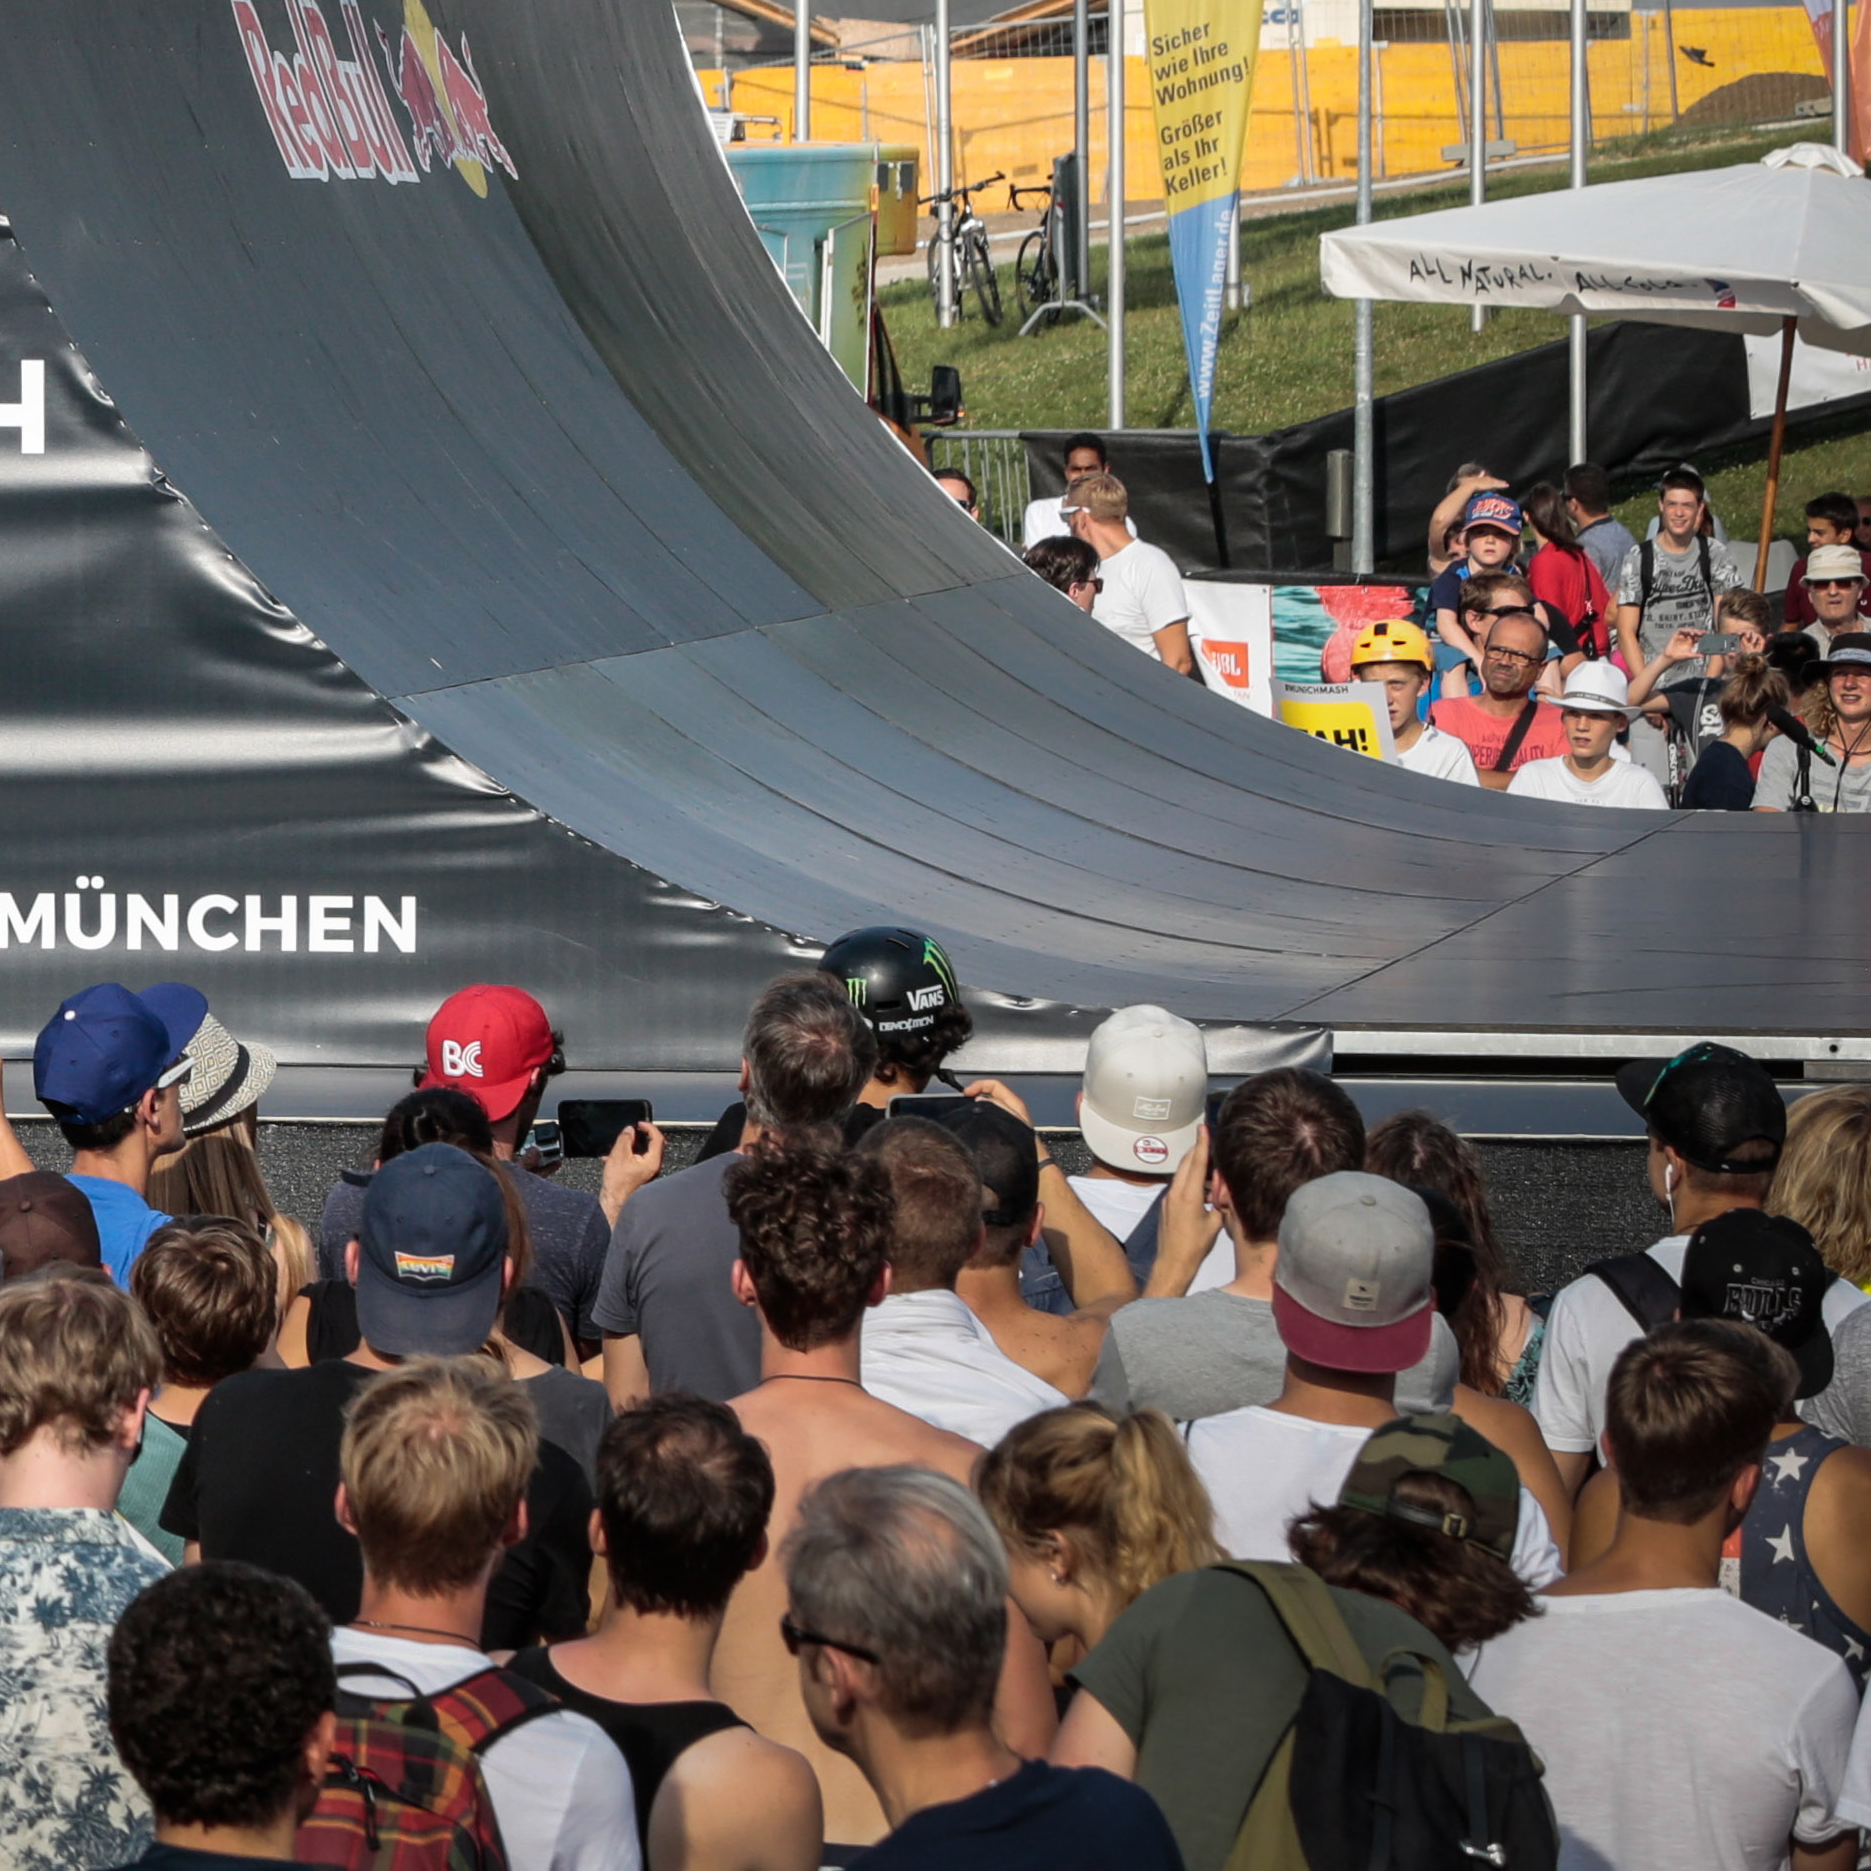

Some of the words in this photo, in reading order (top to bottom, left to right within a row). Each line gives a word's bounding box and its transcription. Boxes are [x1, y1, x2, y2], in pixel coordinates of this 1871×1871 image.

[1152, 22, 1211, 57] Sicher
[1155, 56, 1188, 80] wie
[1193, 41, 1229, 66] Ihre
[1156, 56, 1250, 106] Wohnung!
[1161, 108, 1222, 146] Größer
[1163, 147, 1190, 171] als
[1194, 135, 1219, 158] Ihr
[1165, 156, 1227, 196] Keller!
[1409, 253, 1453, 284] ALL
[1460, 258, 1553, 296] NATURAL.
[1196, 209, 1233, 399] www.ZeitLager.de
[906, 984, 944, 1011] VANS
[879, 1015, 934, 1032] DEMOLITION
[442, 1039, 483, 1077] BC
